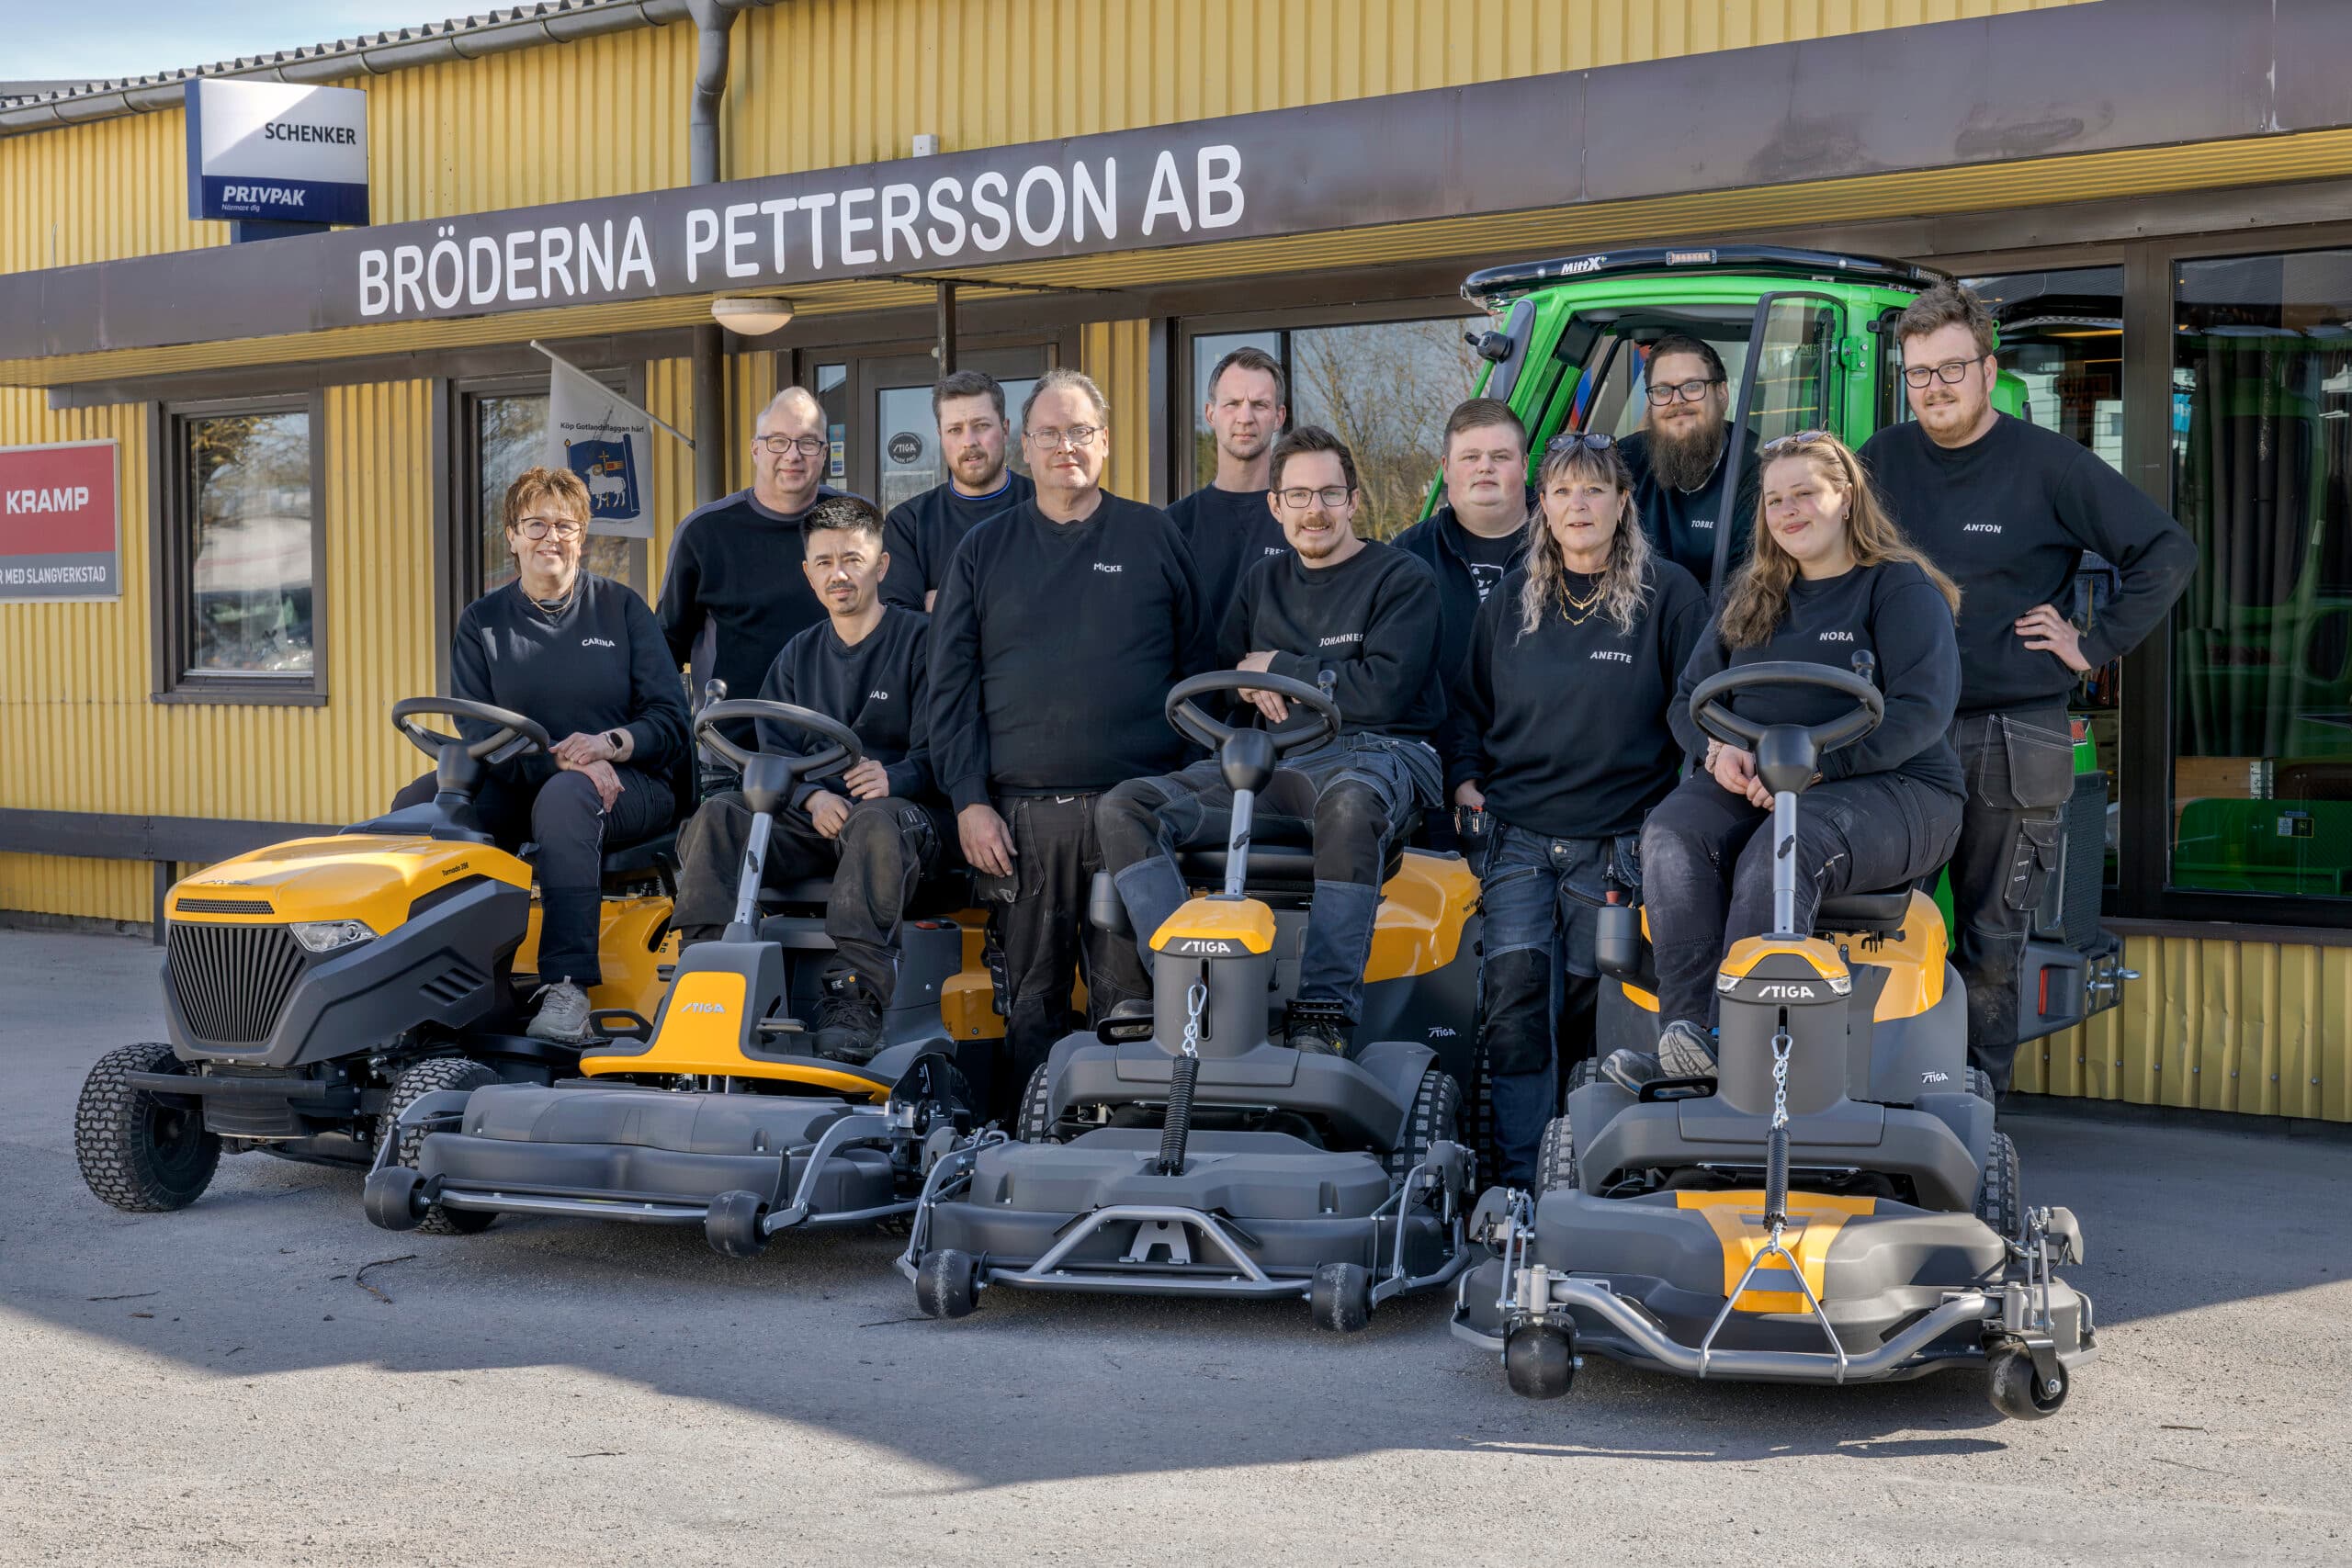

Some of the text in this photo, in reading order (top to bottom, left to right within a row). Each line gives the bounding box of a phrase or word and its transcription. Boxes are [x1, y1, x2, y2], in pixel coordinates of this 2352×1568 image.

[265, 122, 356, 145] SCHENKER
[222, 186, 306, 206] PRIVPAK
[250, 205, 261, 213] dig
[359, 144, 1246, 316] BRÖDERNA PETTERSSON AB
[1560, 256, 1601, 275] MittX
[560, 423, 575, 431] Köp
[892, 443, 917, 454] STIGA
[6, 486, 89, 514] KRAMP
[1690, 520, 1714, 529] TOBBE
[1962, 523, 2002, 534] ANTON
[1093, 561, 1123, 573] MICKE
[5, 567, 26, 585] MED
[26, 565, 107, 584] SLANGVERKSTAD
[1318, 633, 1364, 648] JOHANNES
[1819, 631, 1854, 642] NORA
[1589, 650, 1633, 664] ANETTE
[442, 865, 460, 876] Tornado
[1181, 940, 1231, 953] STIGA
[1758, 985, 1815, 998] STIGA
[681, 1001, 726, 1014] STIGA
[1429, 1028, 1456, 1038] STIGA
[1922, 1072, 1949, 1084] STIGA
